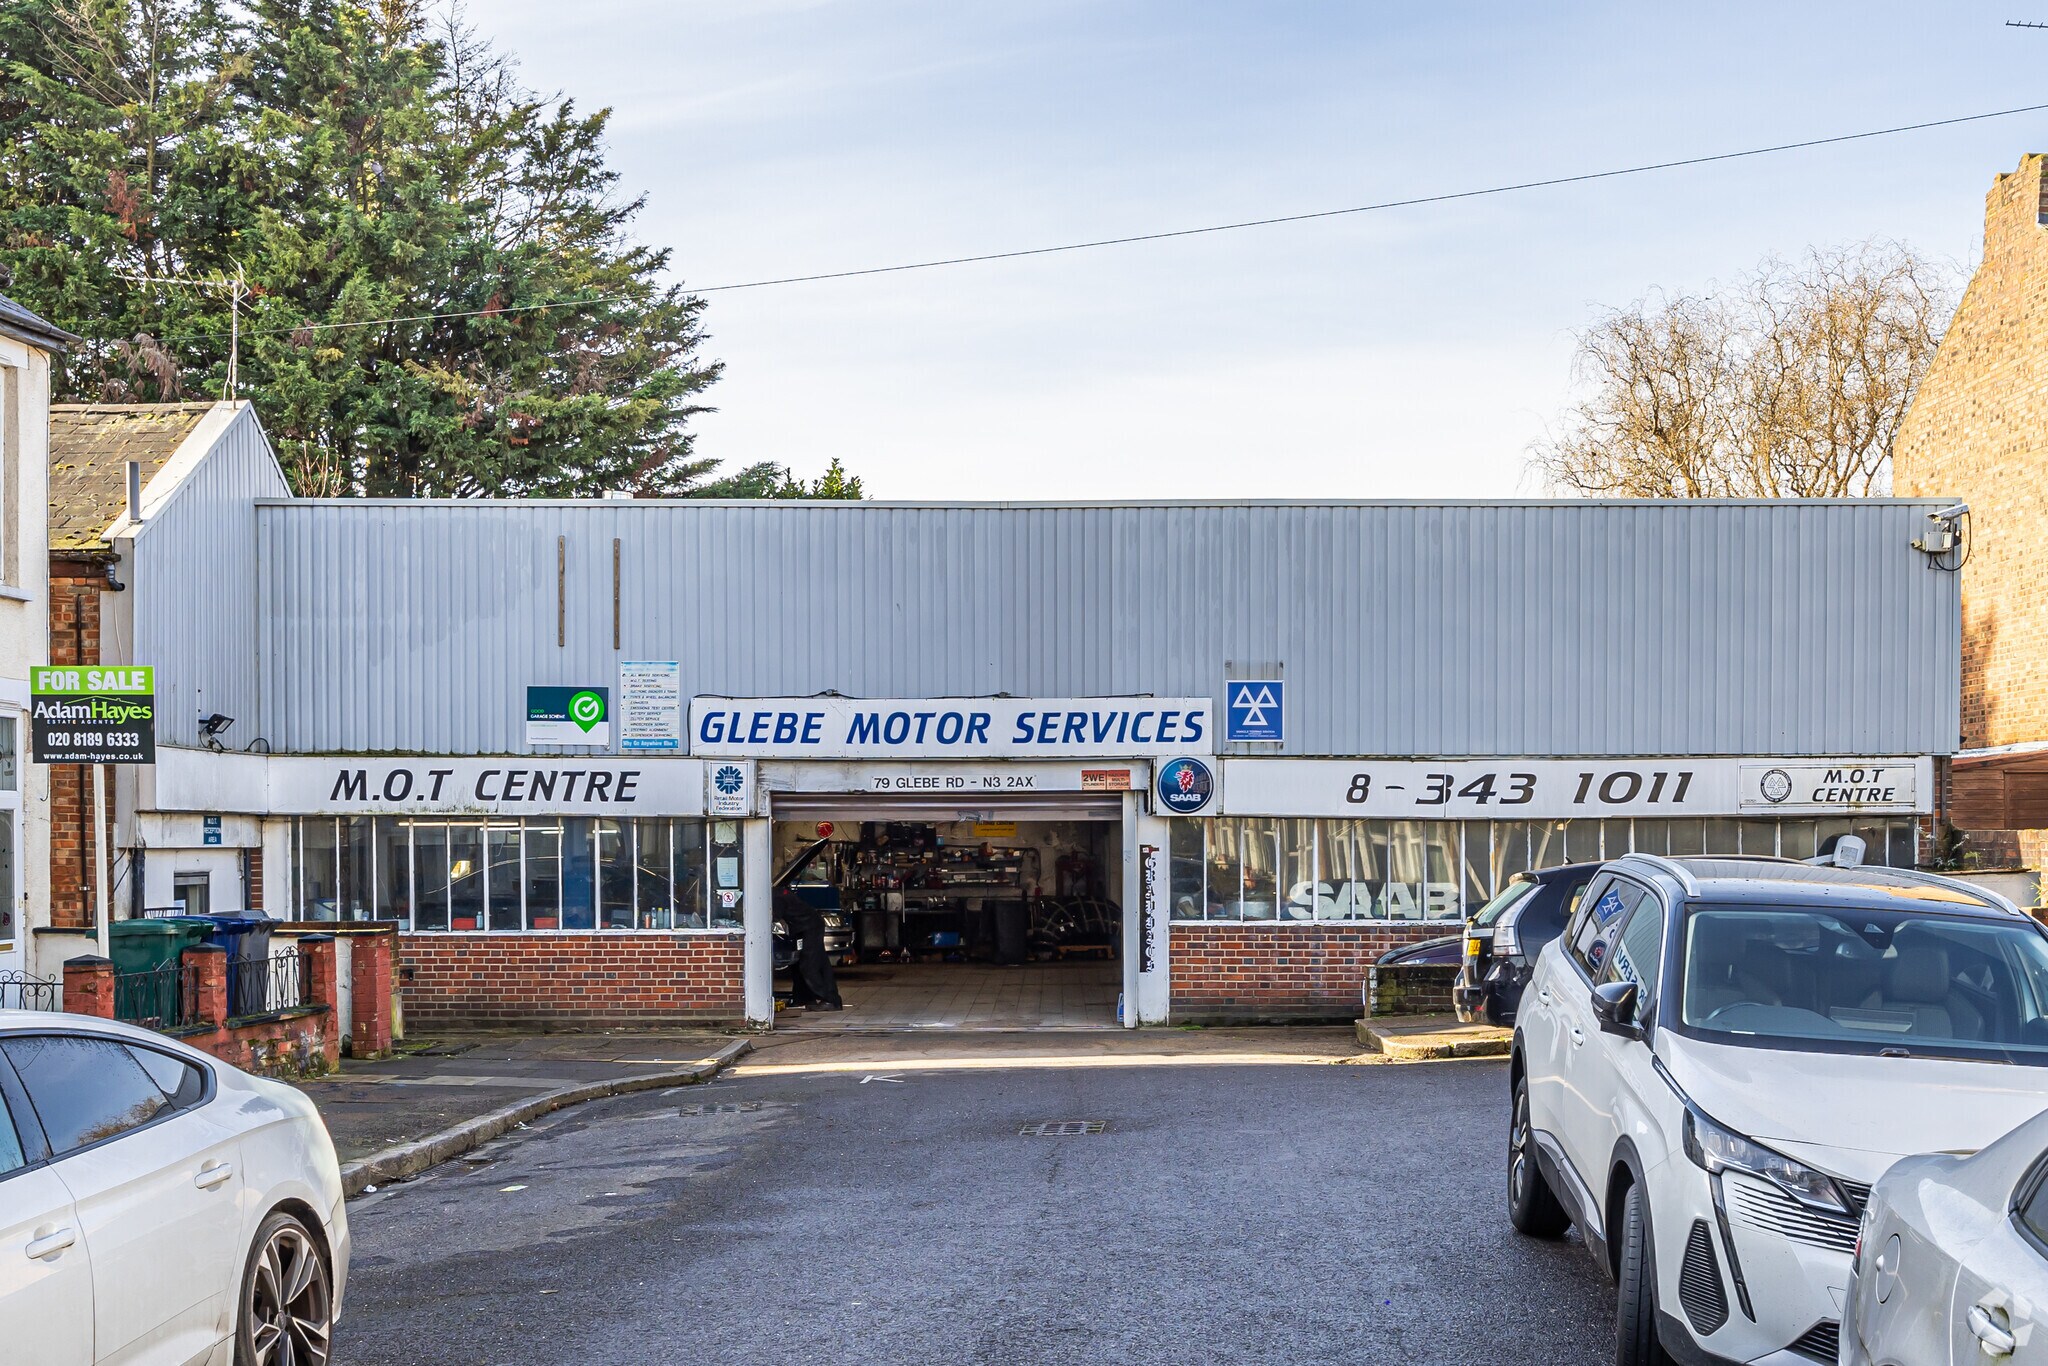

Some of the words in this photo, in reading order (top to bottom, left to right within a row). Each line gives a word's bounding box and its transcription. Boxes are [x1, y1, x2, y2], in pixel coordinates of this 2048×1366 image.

[38, 671, 80, 690] FOR
[87, 671, 145, 690] SALE
[700, 711, 825, 744] GLEBE
[845, 711, 991, 744] MOTOR
[1012, 711, 1205, 744] SERVICES
[47, 732, 70, 746] 020
[73, 732, 103, 746] 8189
[107, 732, 139, 746] 6333
[874, 777, 889, 789] 79
[896, 777, 940, 789] GLEBE
[946, 777, 964, 788] RD
[983, 777, 1001, 788] N3
[1007, 776, 1034, 788] 2AX
[1823, 769, 1884, 783] M.O.T
[330, 768, 453, 801] M.O.T
[474, 769, 641, 802] CENTRE
[1345, 773, 1371, 804] 8
[1415, 773, 1537, 804] 343
[1573, 771, 1693, 804] 1011
[1170, 793, 1201, 802] SAAB
[1812, 787, 1895, 802] CENTRE
[1288, 881, 1460, 920] SAAB
